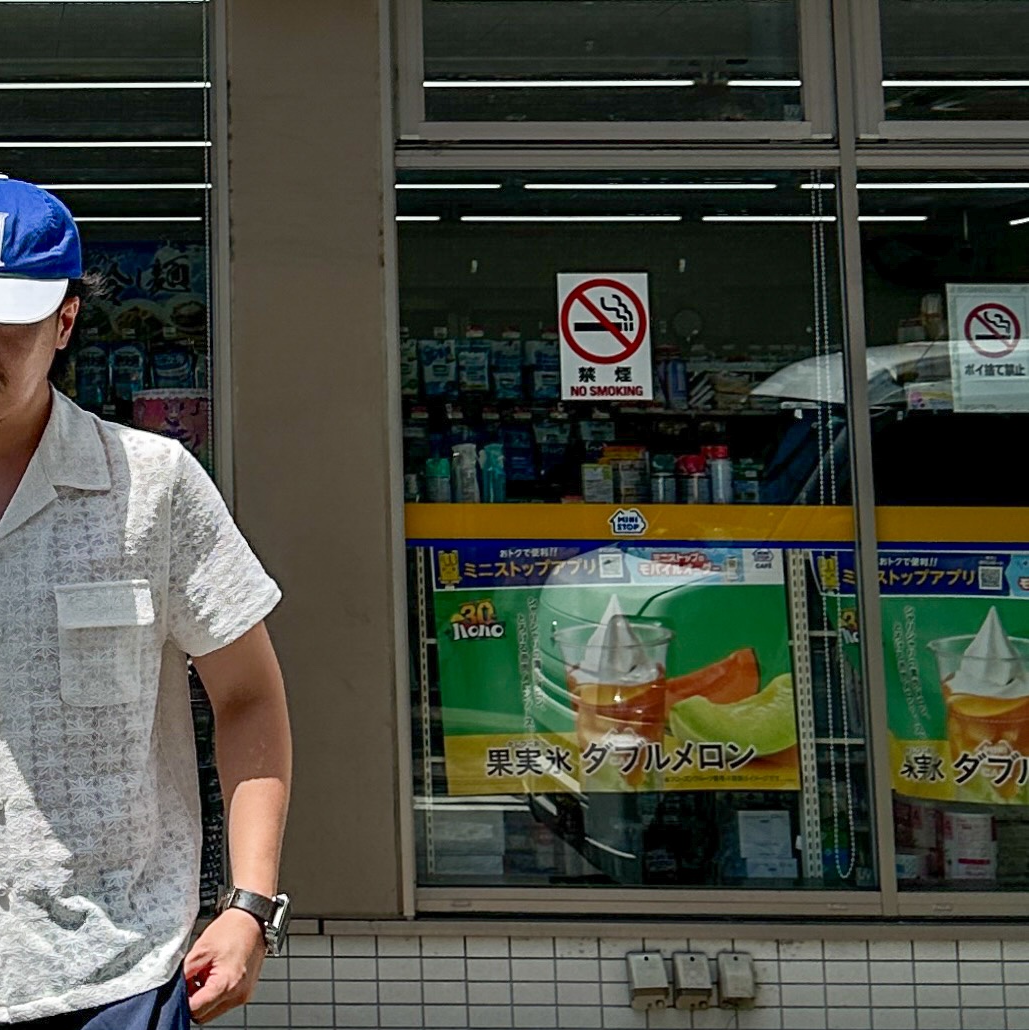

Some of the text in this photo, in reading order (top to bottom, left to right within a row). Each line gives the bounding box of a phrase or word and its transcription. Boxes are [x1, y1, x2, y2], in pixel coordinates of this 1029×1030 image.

[578, 366, 632, 382] 禁煙
[965, 363, 1026, 376] ポイ捨て禁止
[570, 385, 643, 396] NO SMOKING
[618, 516, 638, 524] MINI
[464, 559, 597, 578] ミニストップアプリ
[486, 741, 755, 776] 果実氷 ダブルメロン
